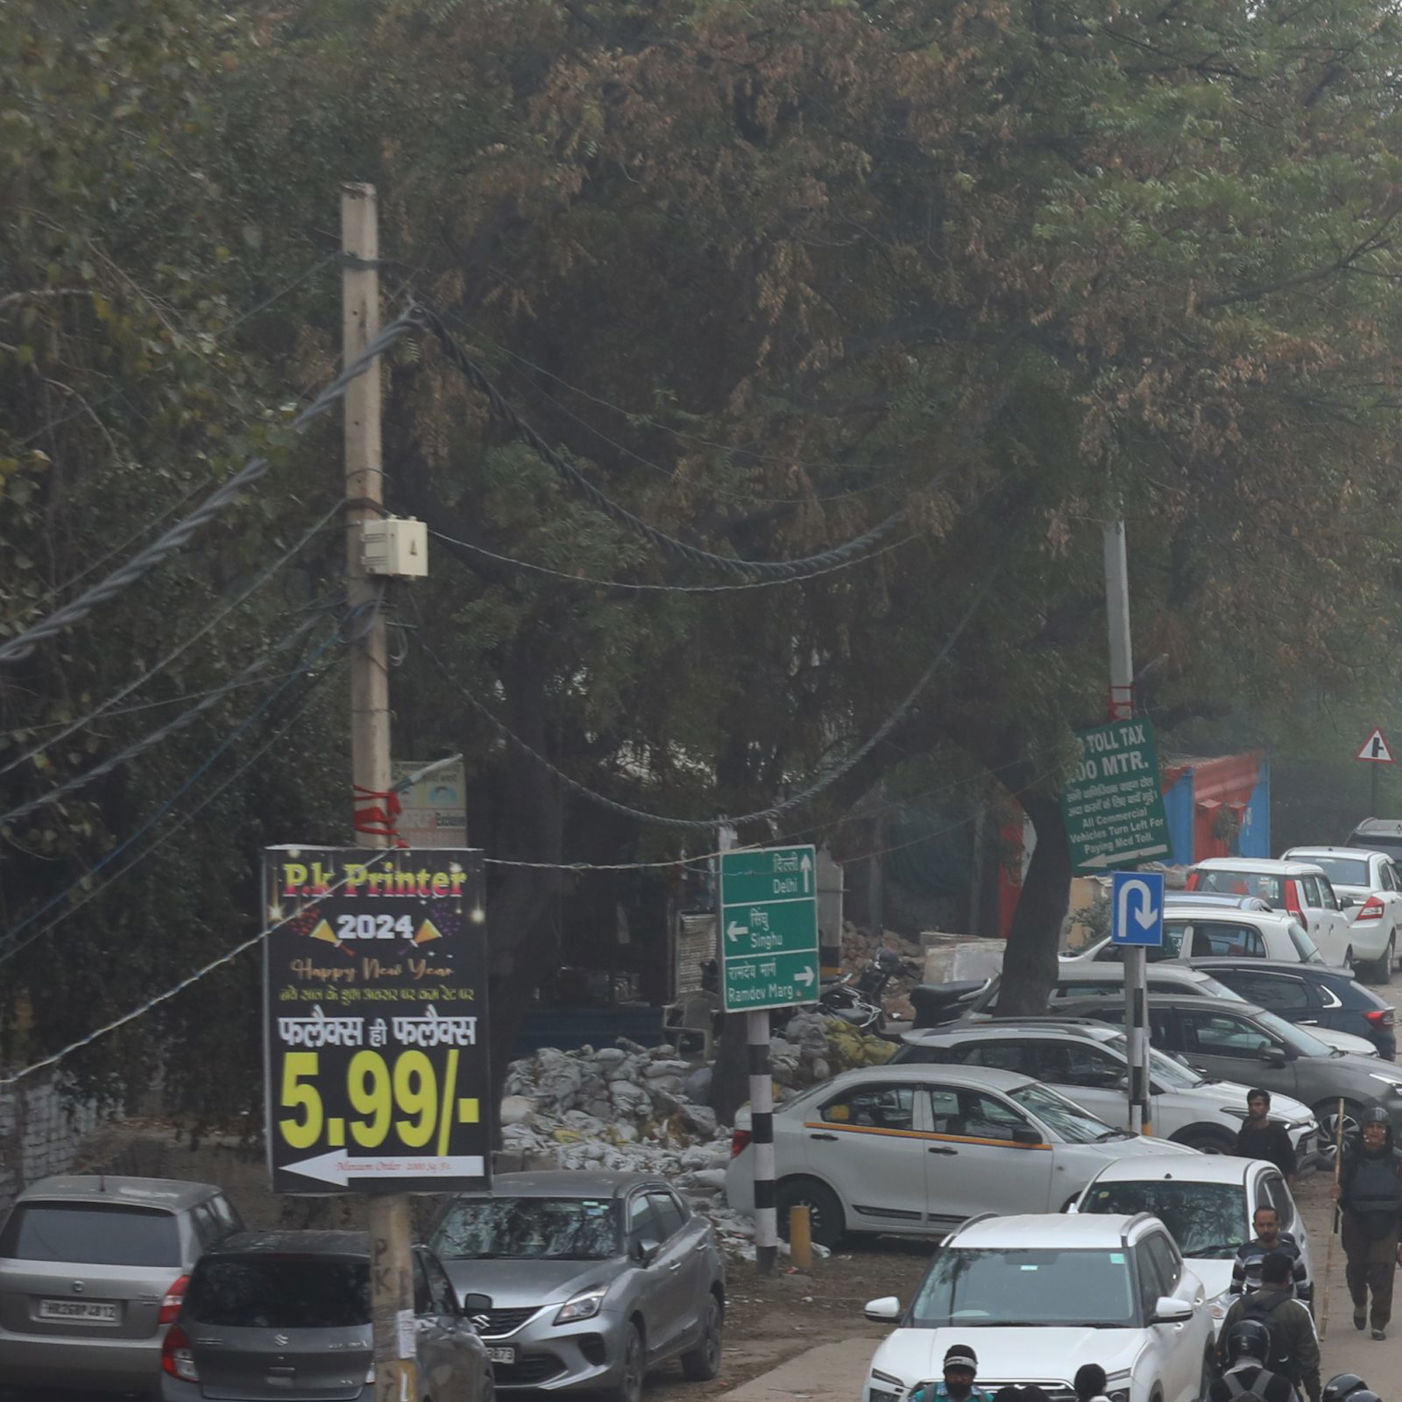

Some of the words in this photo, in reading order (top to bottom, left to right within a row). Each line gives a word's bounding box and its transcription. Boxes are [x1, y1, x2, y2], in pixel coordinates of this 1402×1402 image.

[1086, 731, 1119, 753] TOLL
[1119, 725, 1146, 747] TAX
[1102, 751, 1149, 776] MTR.
[1083, 818, 1095, 828] All
[1096, 806, 1148, 826] Commercial
[1109, 825, 1129, 836] Turn
[1130, 819, 1149, 832] Left
[1149, 818, 1164, 828] For
[1084, 841, 1115, 855] Paying
[773, 852, 799, 873] दिल्ली
[282, 861, 336, 898] P.k
[342, 861, 468, 899] Printer
[772, 877, 798, 895] Delhi
[336, 914, 414, 940] 2024
[750, 931, 783, 950] Singhu
[289, 957, 357, 983] Happy
[362, 957, 403, 981] New
[407, 957, 455, 980] Year
[728, 960, 757, 982] रामदेव
[759, 957, 777, 978] मार्ग
[326, 985, 339, 1001] के
[728, 986, 767, 1003] Ramdev
[767, 983, 794, 1000] Marg
[368, 1017, 389, 1047] ही
[279, 1049, 480, 1157] 5.99/-
